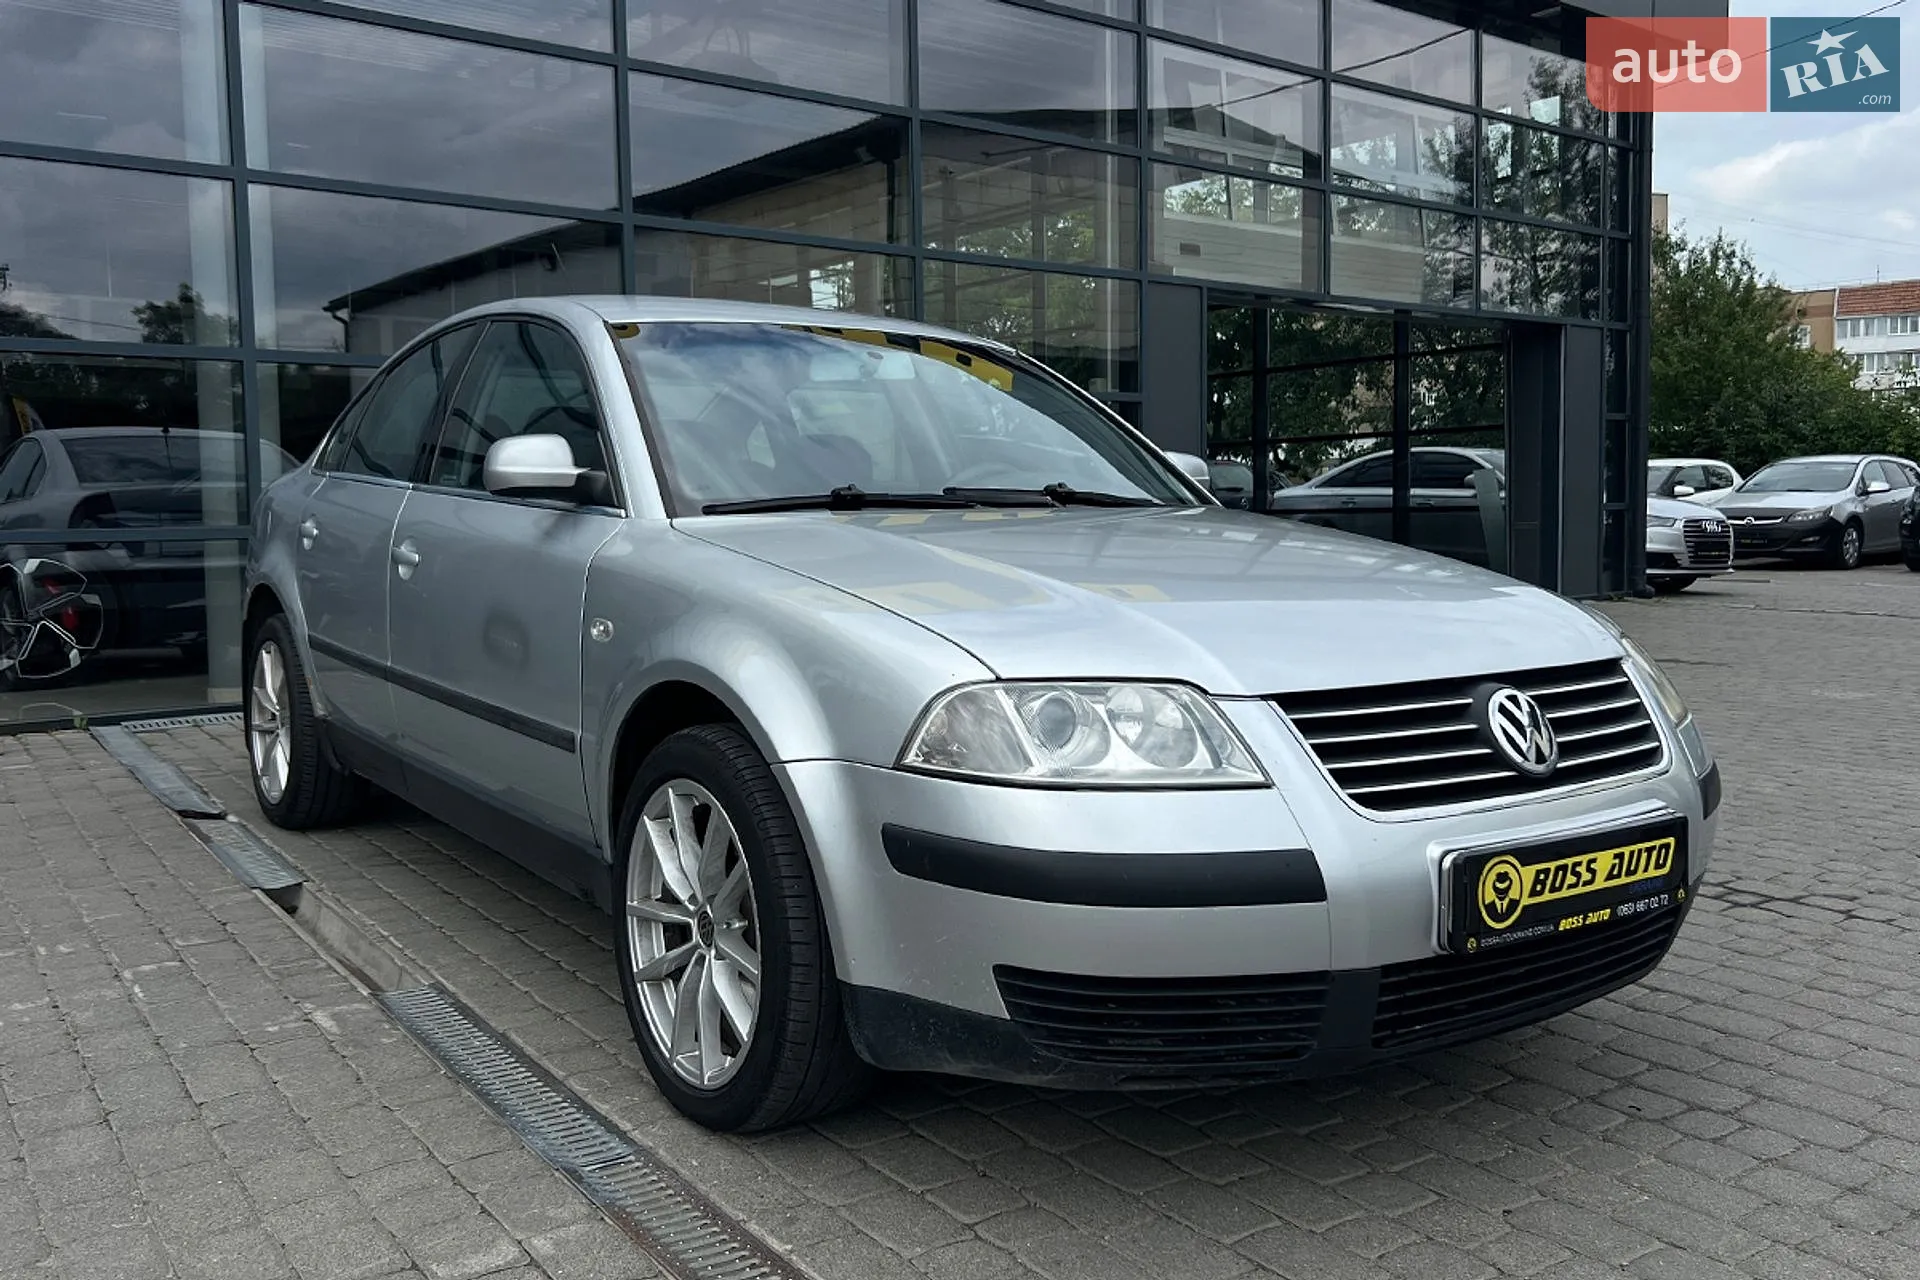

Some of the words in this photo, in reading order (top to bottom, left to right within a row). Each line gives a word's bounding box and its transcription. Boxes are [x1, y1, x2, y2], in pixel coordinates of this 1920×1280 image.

[1528, 857, 1597, 898] BOSS
[1603, 842, 1671, 882] AUTO
[1558, 915, 1583, 931] BOSS
[1585, 908, 1611, 924] AUTO
